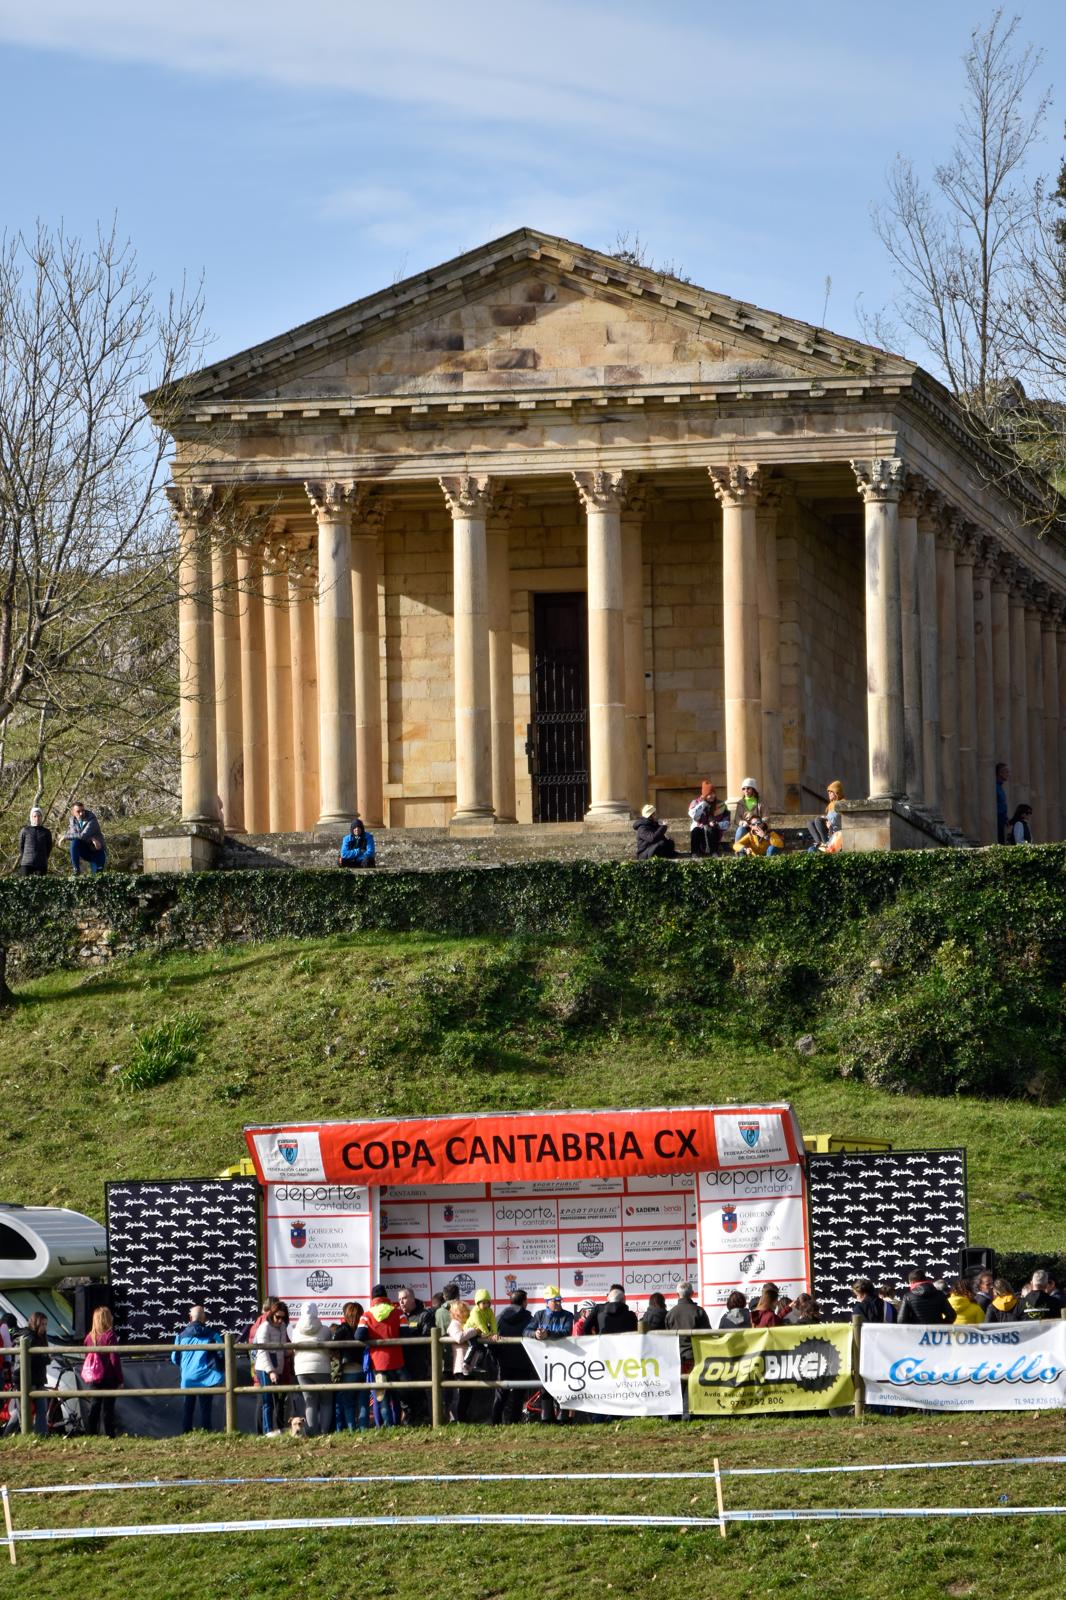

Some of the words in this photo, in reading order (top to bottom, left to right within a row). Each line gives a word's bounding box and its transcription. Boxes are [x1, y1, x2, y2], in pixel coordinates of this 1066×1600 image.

[341, 1139, 436, 1170] COPA
[445, 1131, 644, 1165] CANTABRIA
[654, 1129, 699, 1159] CX
[744, 1183, 793, 1194] cantabria
[314, 1200, 361, 1211] cantabria
[308, 1227, 343, 1235] GOBIERNO
[919, 1331, 1020, 1346] AUTOBUSES
[544, 1355, 660, 1392] ingeven
[889, 1354, 1062, 1384] Castillo
[615, 1379, 661, 1388] VENTANAS
[768, 1397, 784, 1405] 806
